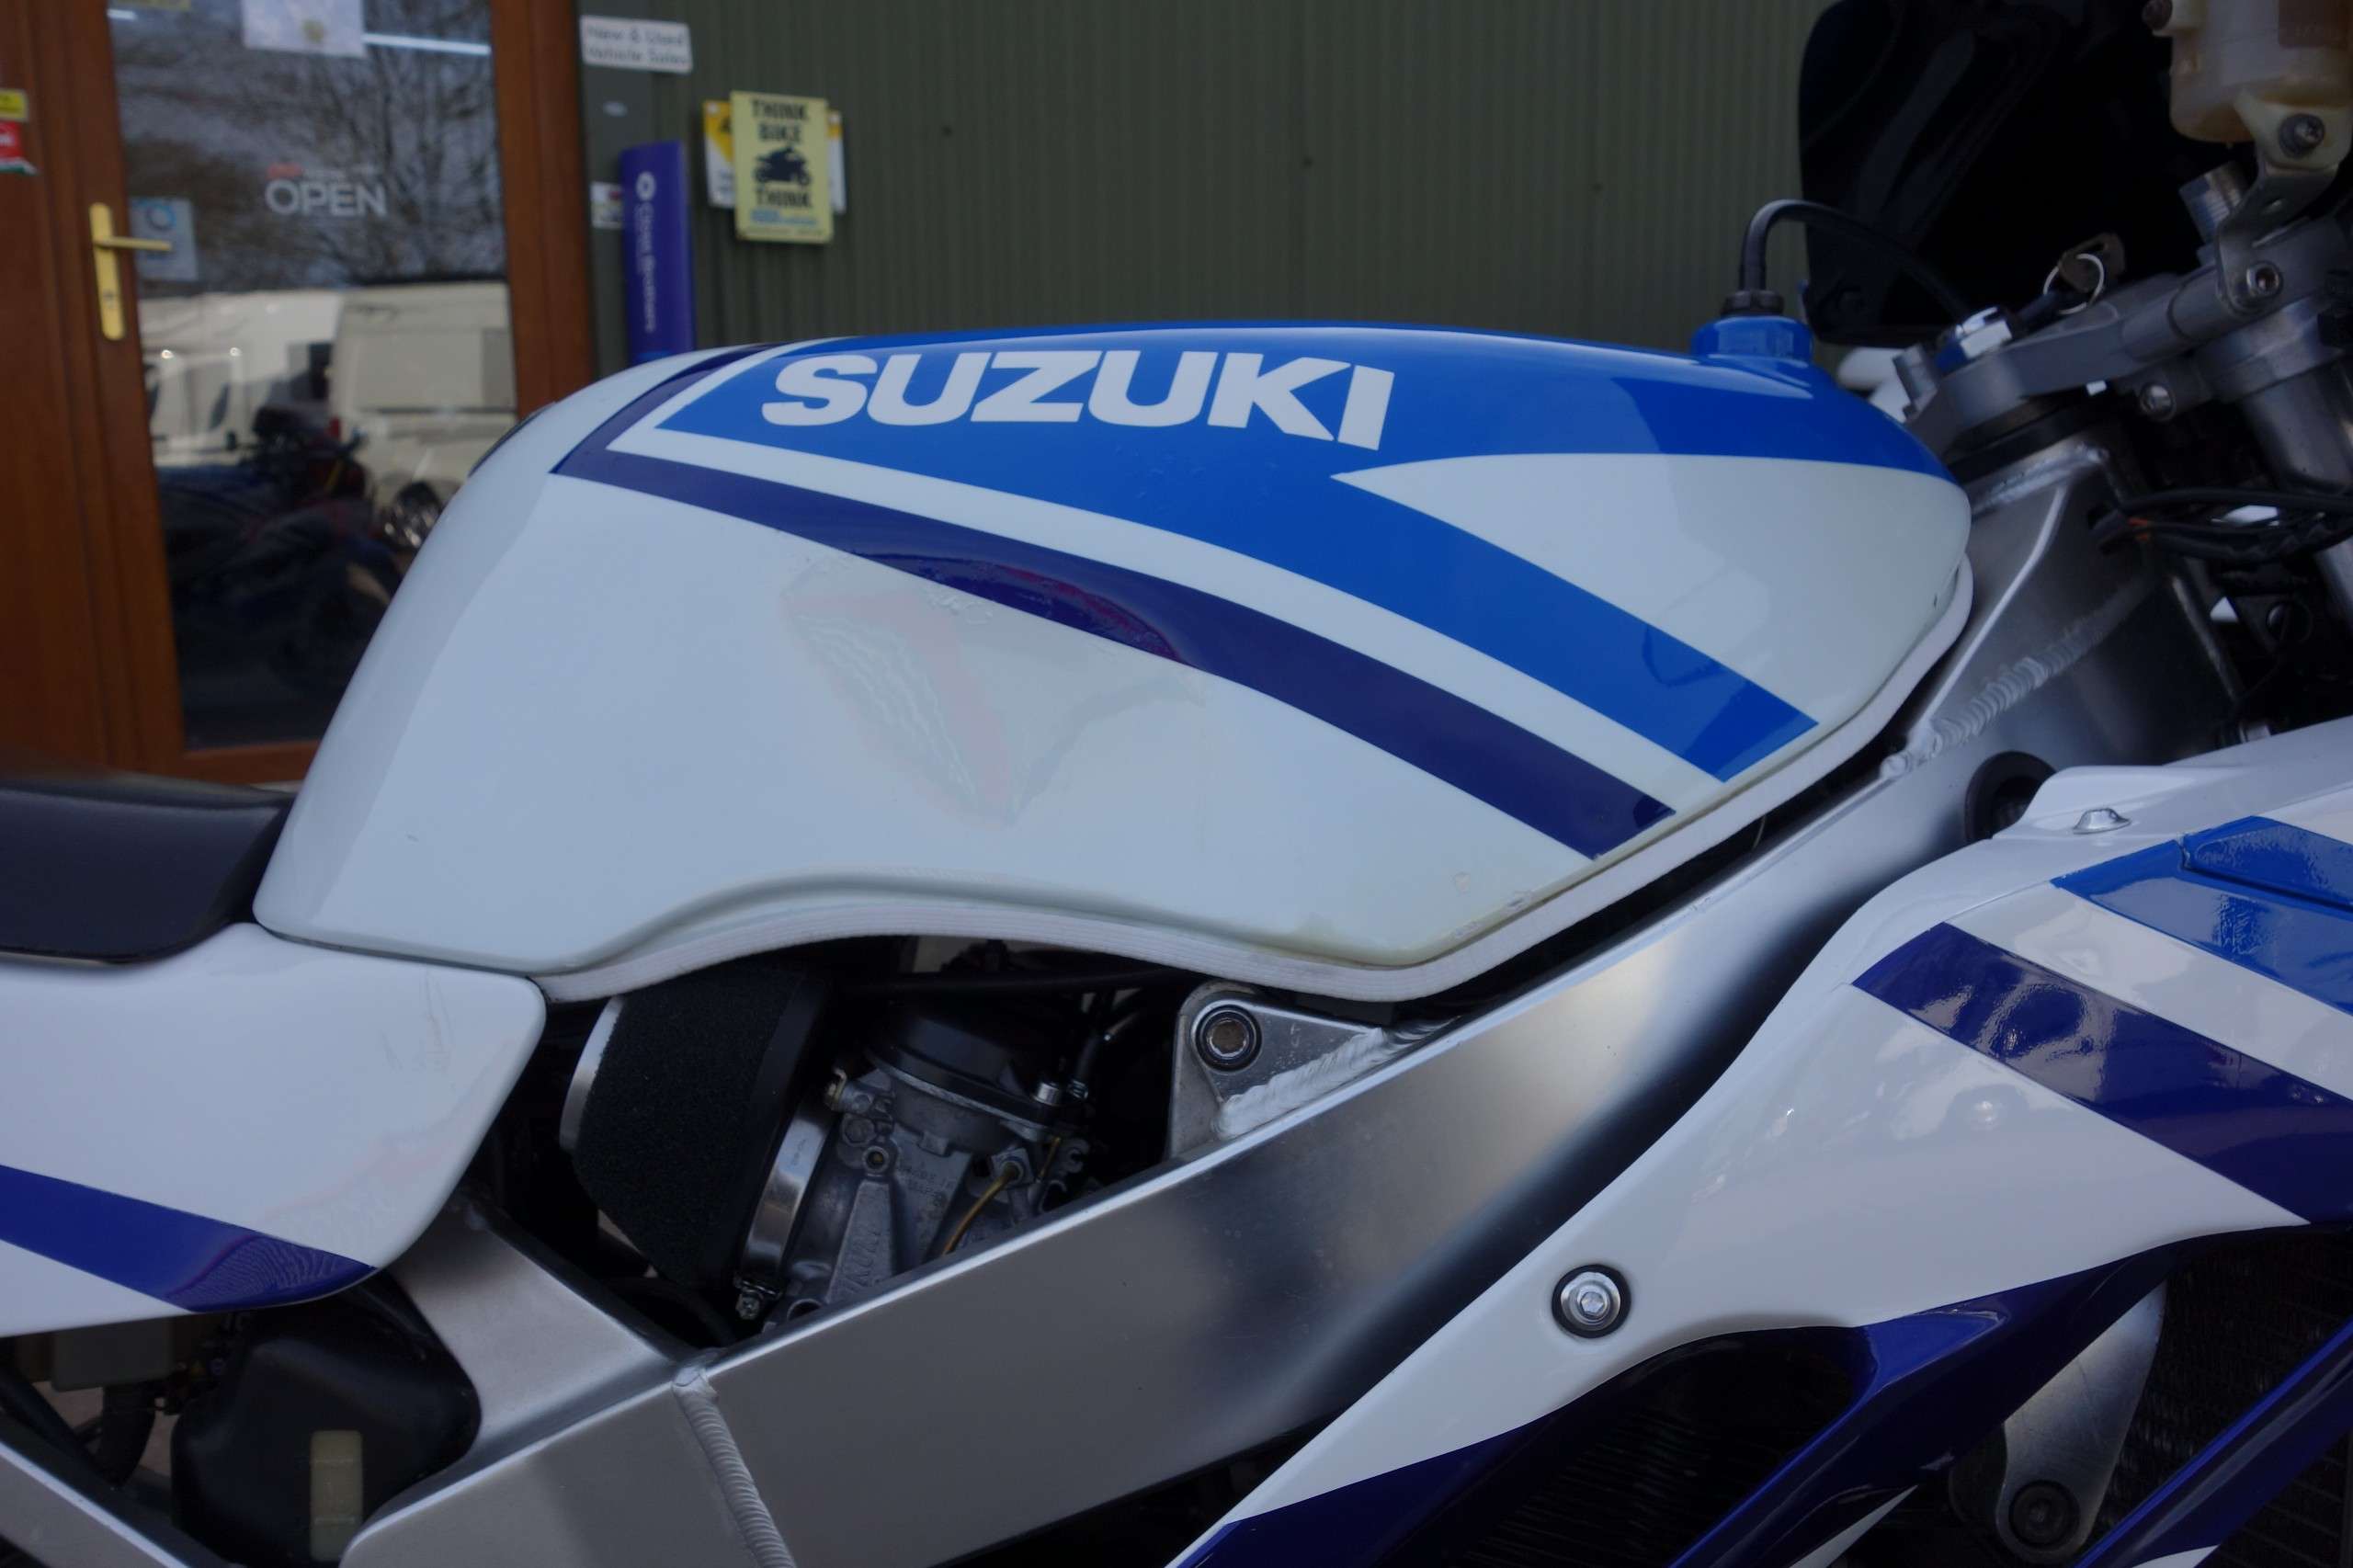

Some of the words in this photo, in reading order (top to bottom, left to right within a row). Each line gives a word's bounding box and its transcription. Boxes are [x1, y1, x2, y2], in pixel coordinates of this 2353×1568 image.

[752, 99, 808, 120] THINK
[757, 122, 802, 143] BIKE
[265, 179, 387, 217] OPEN
[756, 187, 813, 209] THINK
[762, 350, 1394, 449] SUZUKI
